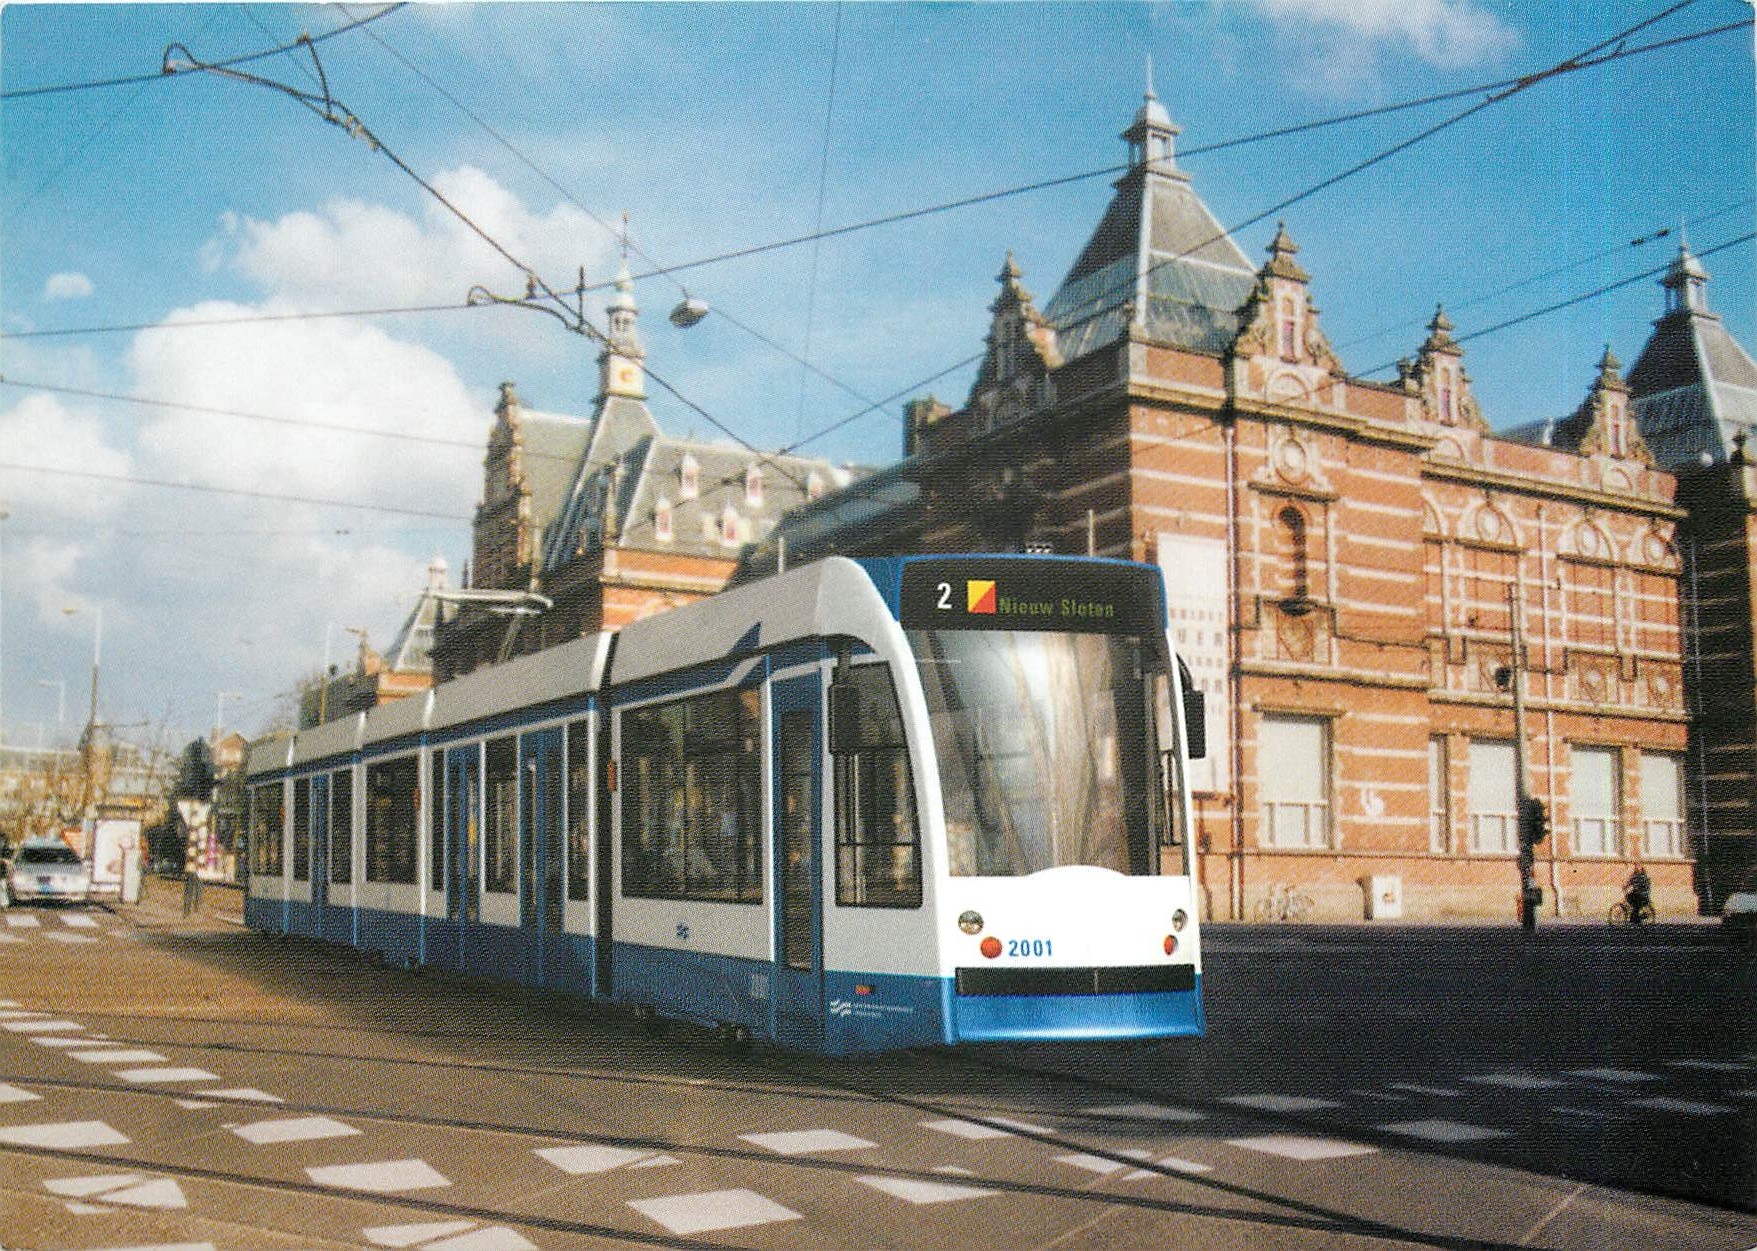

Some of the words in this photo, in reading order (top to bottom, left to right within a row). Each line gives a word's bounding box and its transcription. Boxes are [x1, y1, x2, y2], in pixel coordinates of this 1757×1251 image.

[936, 582, 953, 609] 2
[999, 598, 1052, 616] Nieuw
[1061, 599, 1114, 617] Sloten
[1009, 939, 1053, 957] 2001
